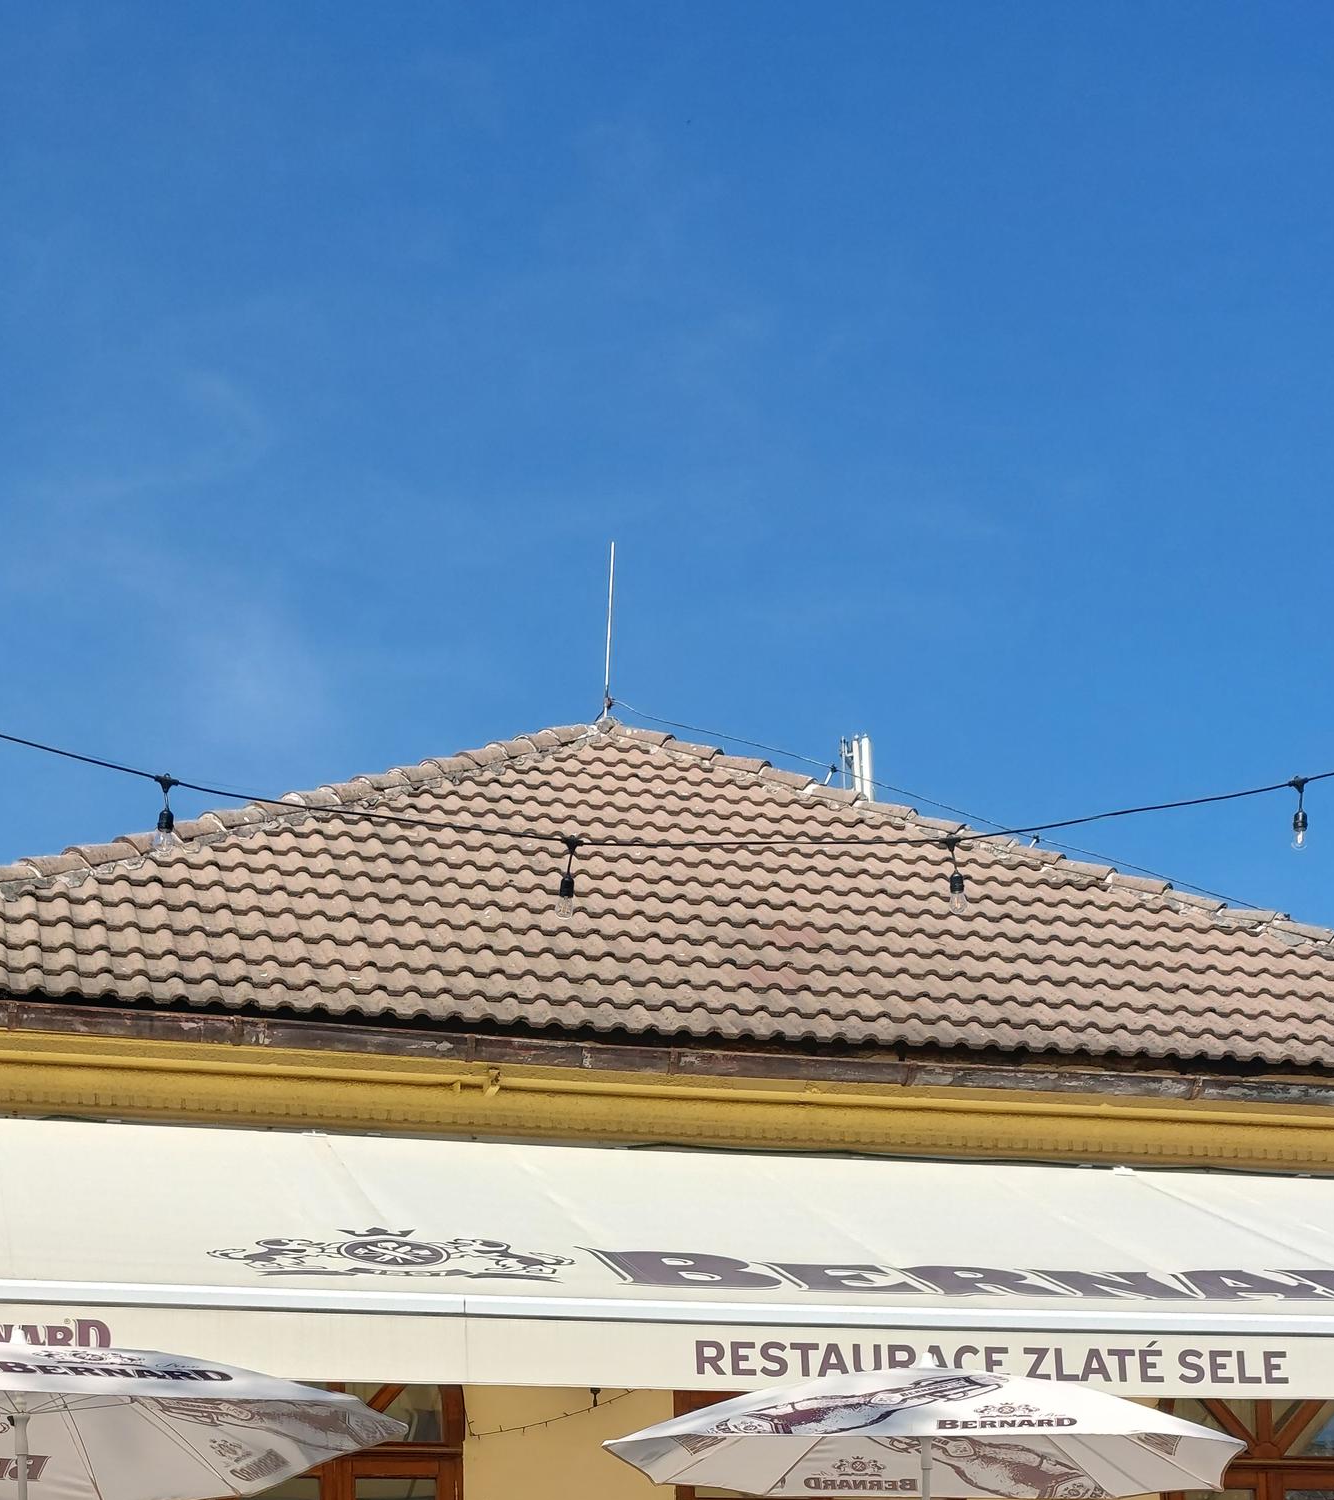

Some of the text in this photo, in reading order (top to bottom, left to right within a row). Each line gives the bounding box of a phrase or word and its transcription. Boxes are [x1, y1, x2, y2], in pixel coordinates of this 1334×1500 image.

[695, 1340, 1290, 1384] RESTAURACE ZLATÉ SELE
[936, 1417, 1078, 1431] BERNARD
